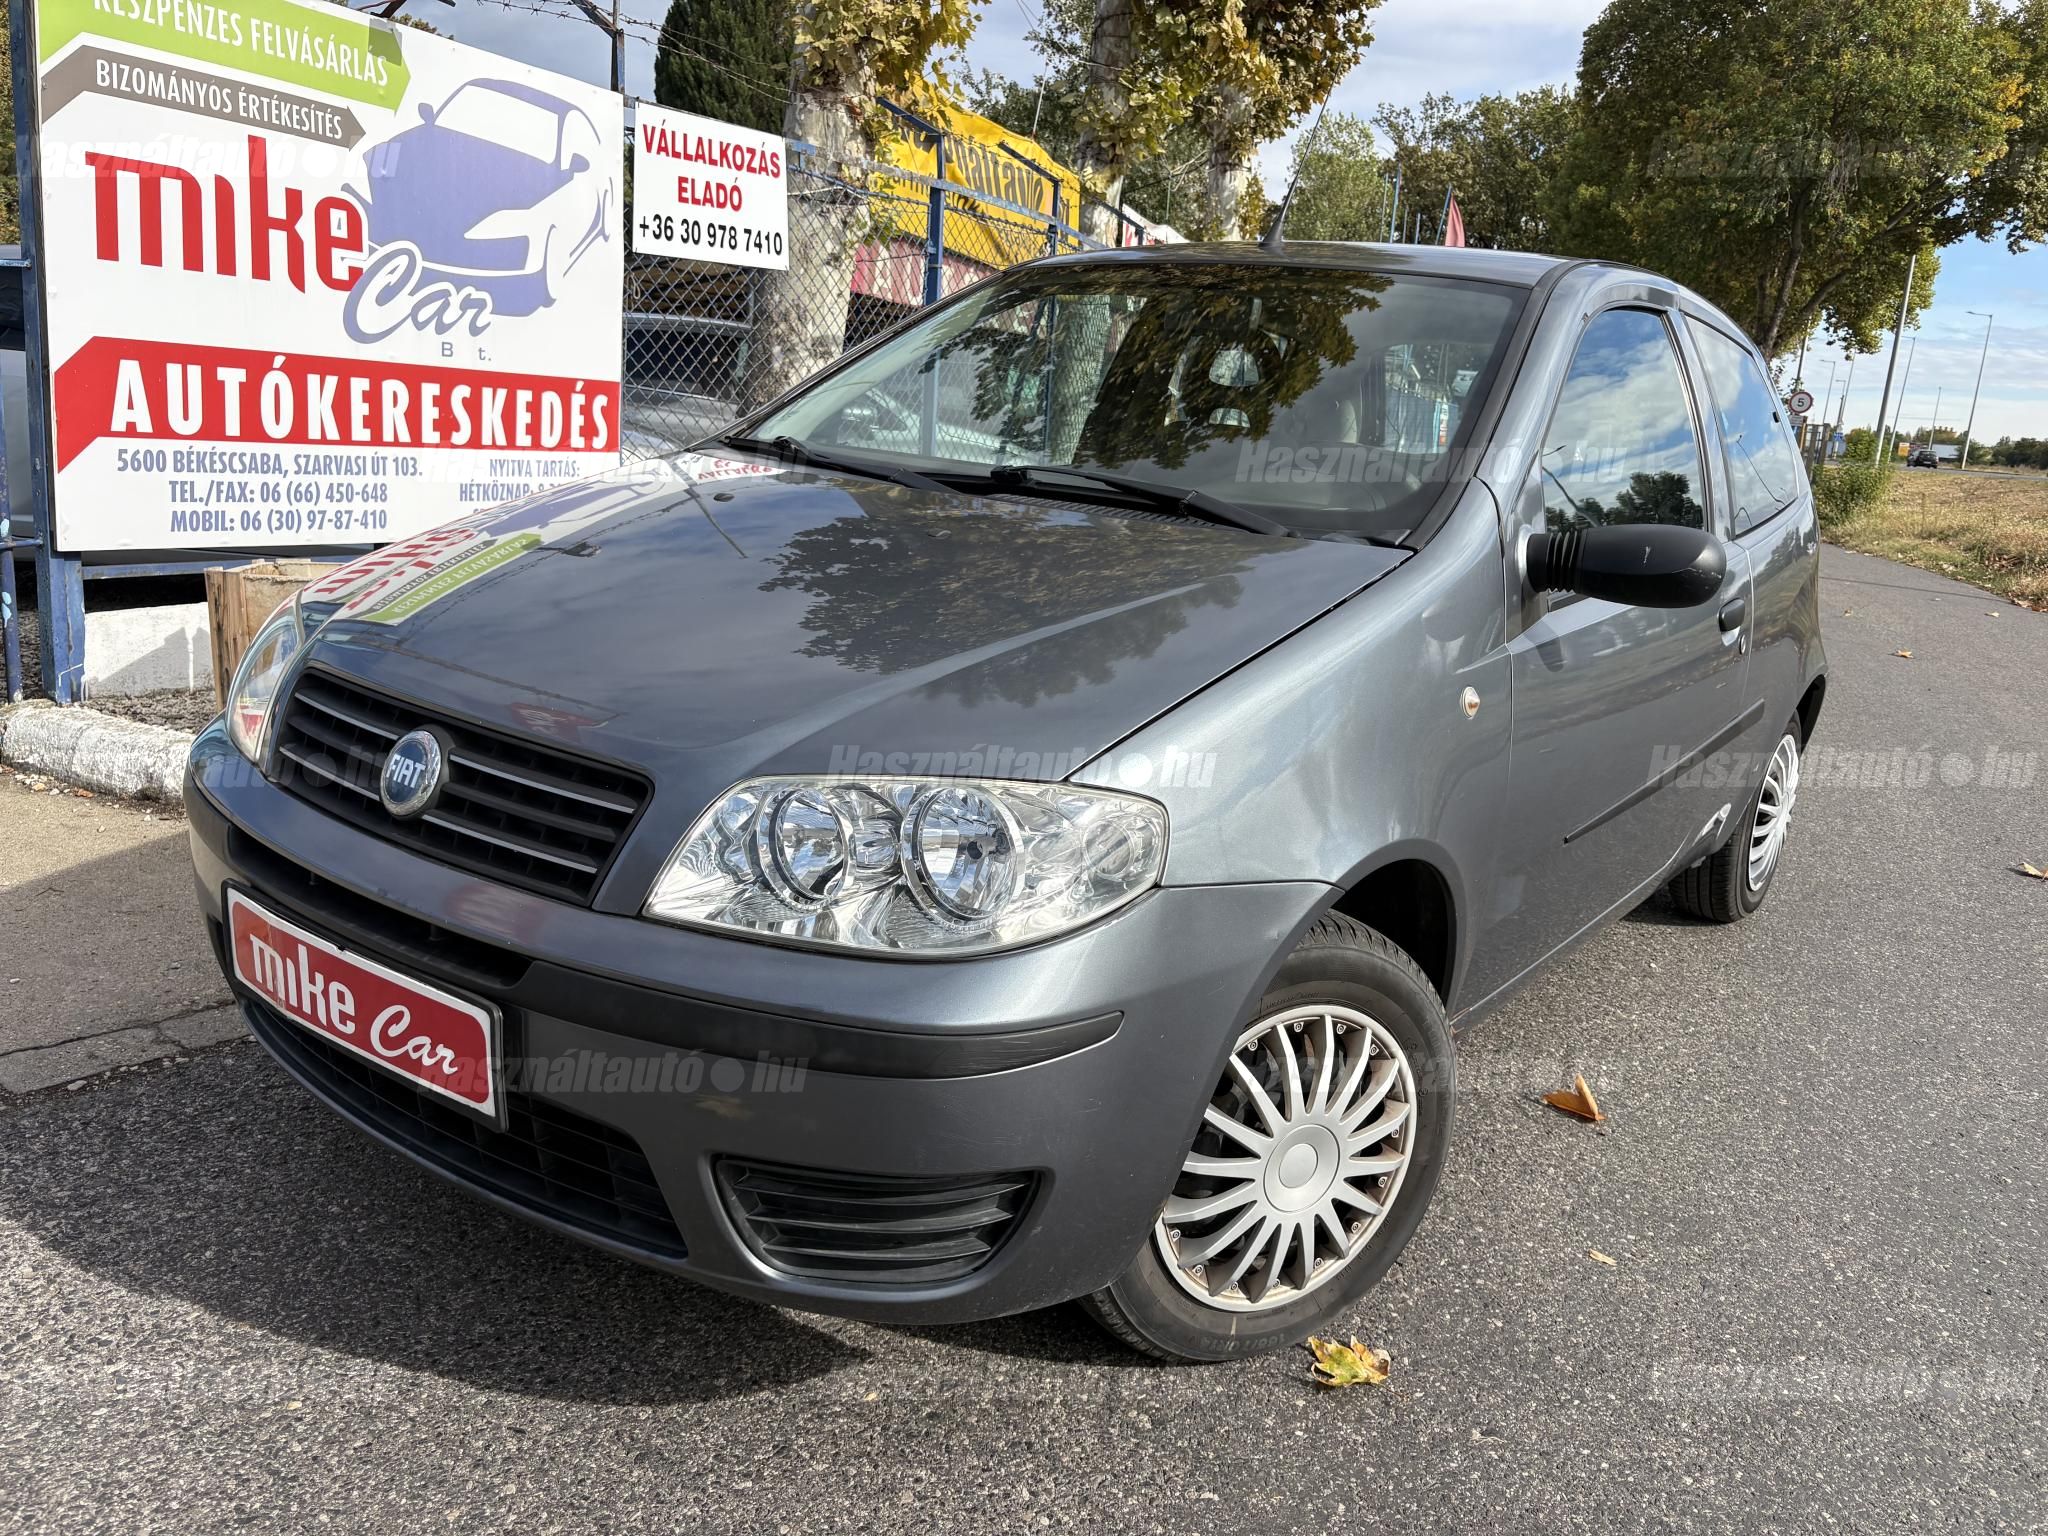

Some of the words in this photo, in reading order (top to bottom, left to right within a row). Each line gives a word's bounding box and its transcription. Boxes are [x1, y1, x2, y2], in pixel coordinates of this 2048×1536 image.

[251, 18, 388, 87] FELVÁSÁRLÁS
[96, 59, 233, 114] BIZOMÁNYOS
[239, 86, 343, 140] ÉRTÉKESÍTÉS
[642, 119, 781, 178] VÁLLALKOZÁS
[85, 134, 364, 294] mike
[677, 177, 743, 212] ELADÓ
[639, 213, 674, 242] +36
[680, 218, 701, 246] 30
[707, 222, 738, 251] 978
[743, 228, 783, 256] 7410
[341, 246, 492, 345] Car
[110, 355, 609, 450] AUTÓKERESKEDÉS
[1797, 398, 1805, 407] 5
[117, 448, 167, 473] 5600
[173, 445, 290, 479] BÉKÉSCSABA,
[294, 453, 367, 477] SZARVASI
[371, 450, 389, 477] ÚT
[392, 456, 424, 477] 103.
[489, 459, 533, 478] NYITVA
[536, 456, 581, 478] TARTÁS:
[169, 480, 256, 507] TEL./FAX:
[260, 481, 282, 503] 06
[286, 480, 321, 507] (66)
[325, 482, 389, 504] 450-648
[170, 510, 236, 533] MOBIL:
[240, 510, 262, 531] 06
[267, 508, 302, 534] (30)
[306, 509, 388, 531] 97-87-410
[385, 753, 427, 789] FIAT
[249, 933, 356, 1035] mike
[370, 1004, 459, 1075] Car
